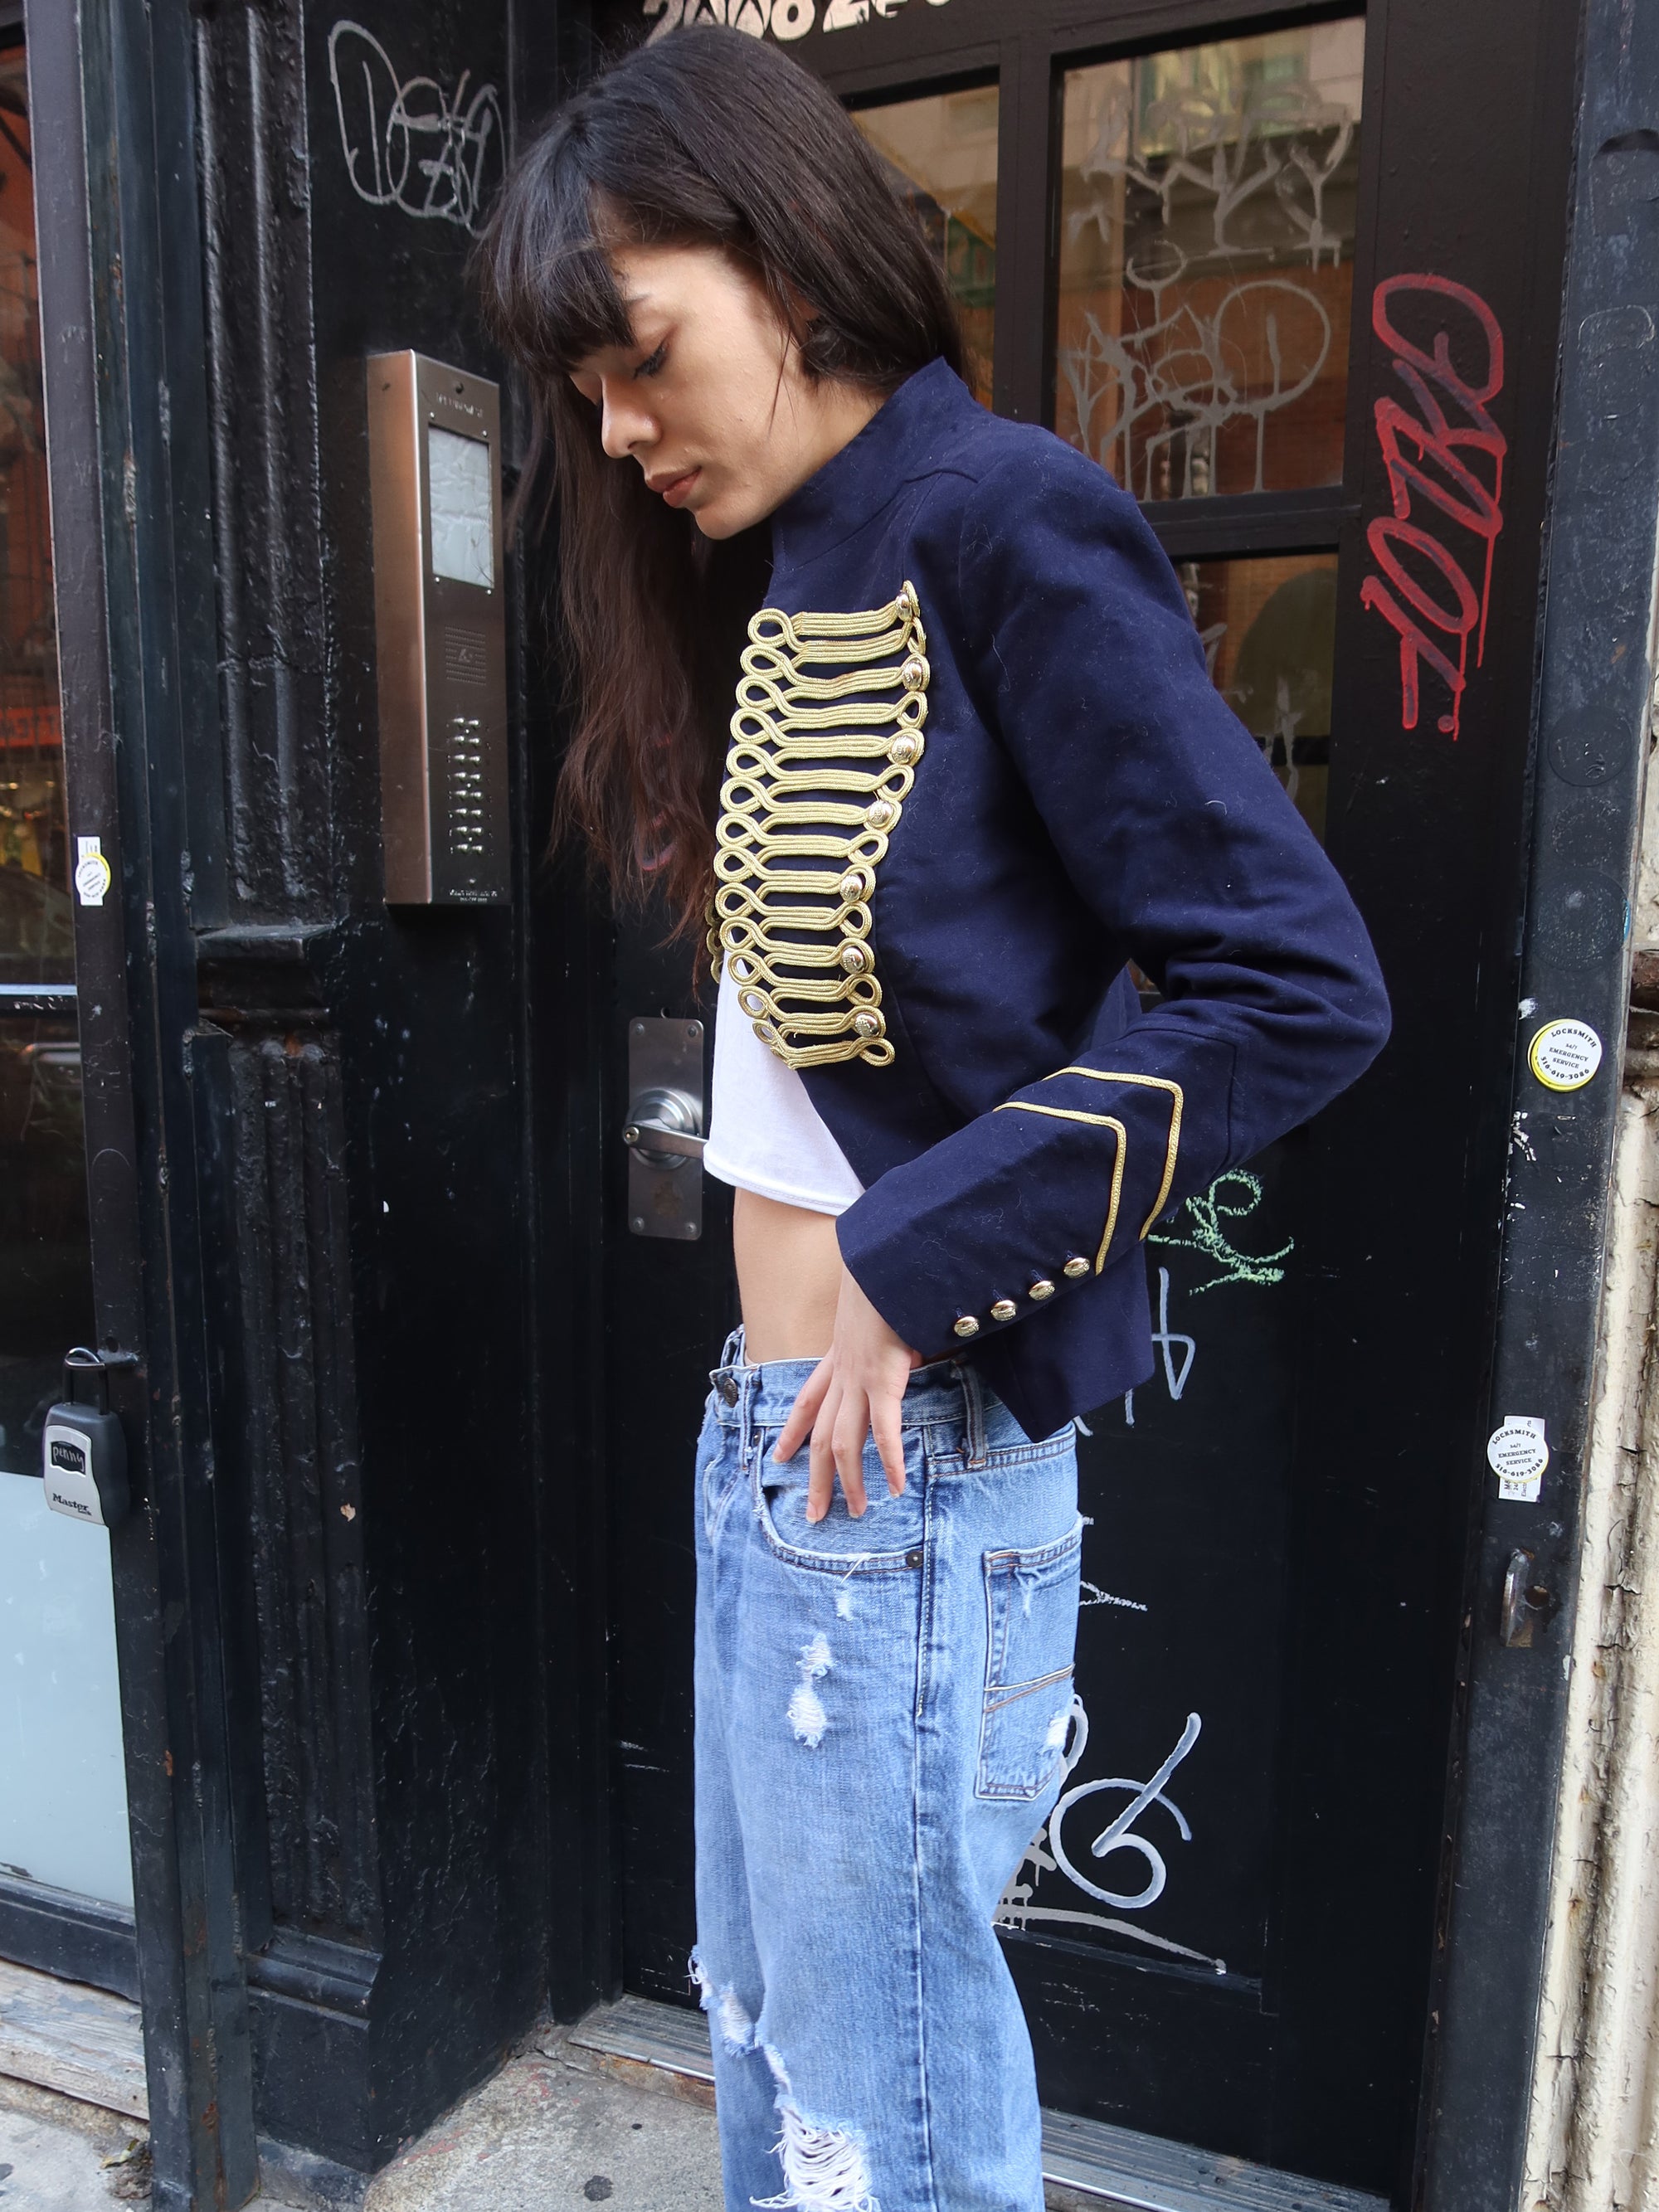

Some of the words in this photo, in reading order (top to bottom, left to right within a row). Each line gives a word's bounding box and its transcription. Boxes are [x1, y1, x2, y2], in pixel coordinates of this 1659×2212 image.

[1551, 1028, 1597, 1048] LOCKSMITH
[1549, 1047, 1589, 1062] EMERGENCY
[1552, 1057, 1580, 1069] SERVICE
[1492, 1429, 1536, 1445] LOCKSMITH
[1498, 1448, 1536, 1458] EMERGENCY
[1506, 1457, 1533, 1466] SERVICE
[52, 1493, 89, 1511] Master
